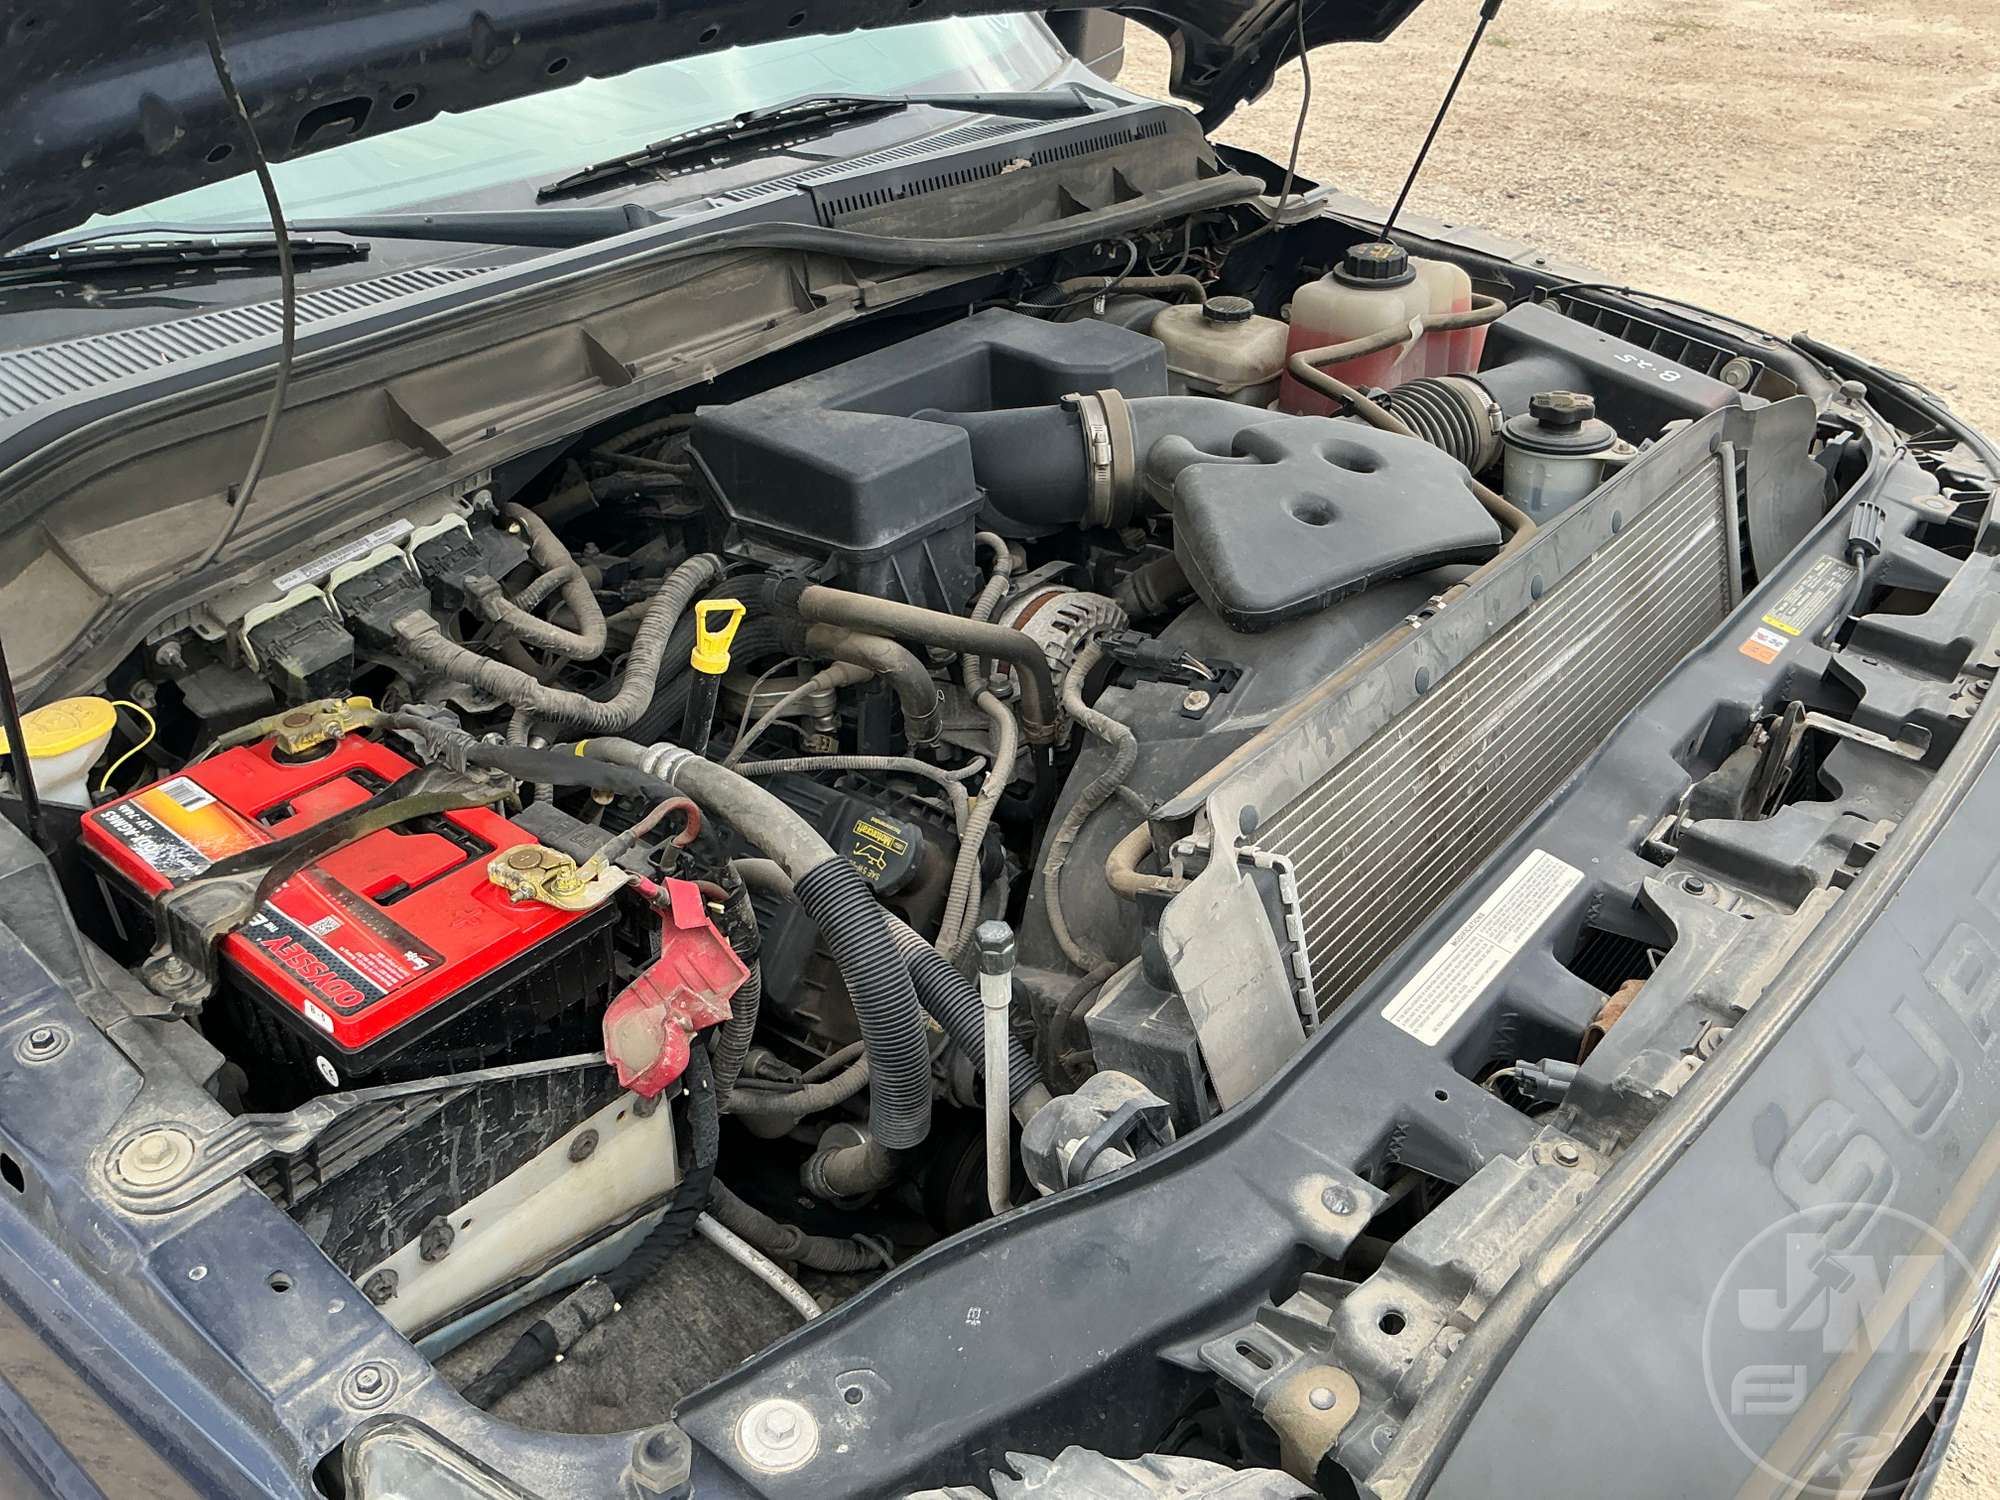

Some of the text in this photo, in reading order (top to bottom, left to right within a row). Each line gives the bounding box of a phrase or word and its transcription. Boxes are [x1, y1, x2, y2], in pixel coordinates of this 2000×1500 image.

[856, 822, 893, 848] Motorcraft
[1450, 911, 1486, 947] MODIFICATIONS
[260, 935, 366, 1008] ODYSSEY
